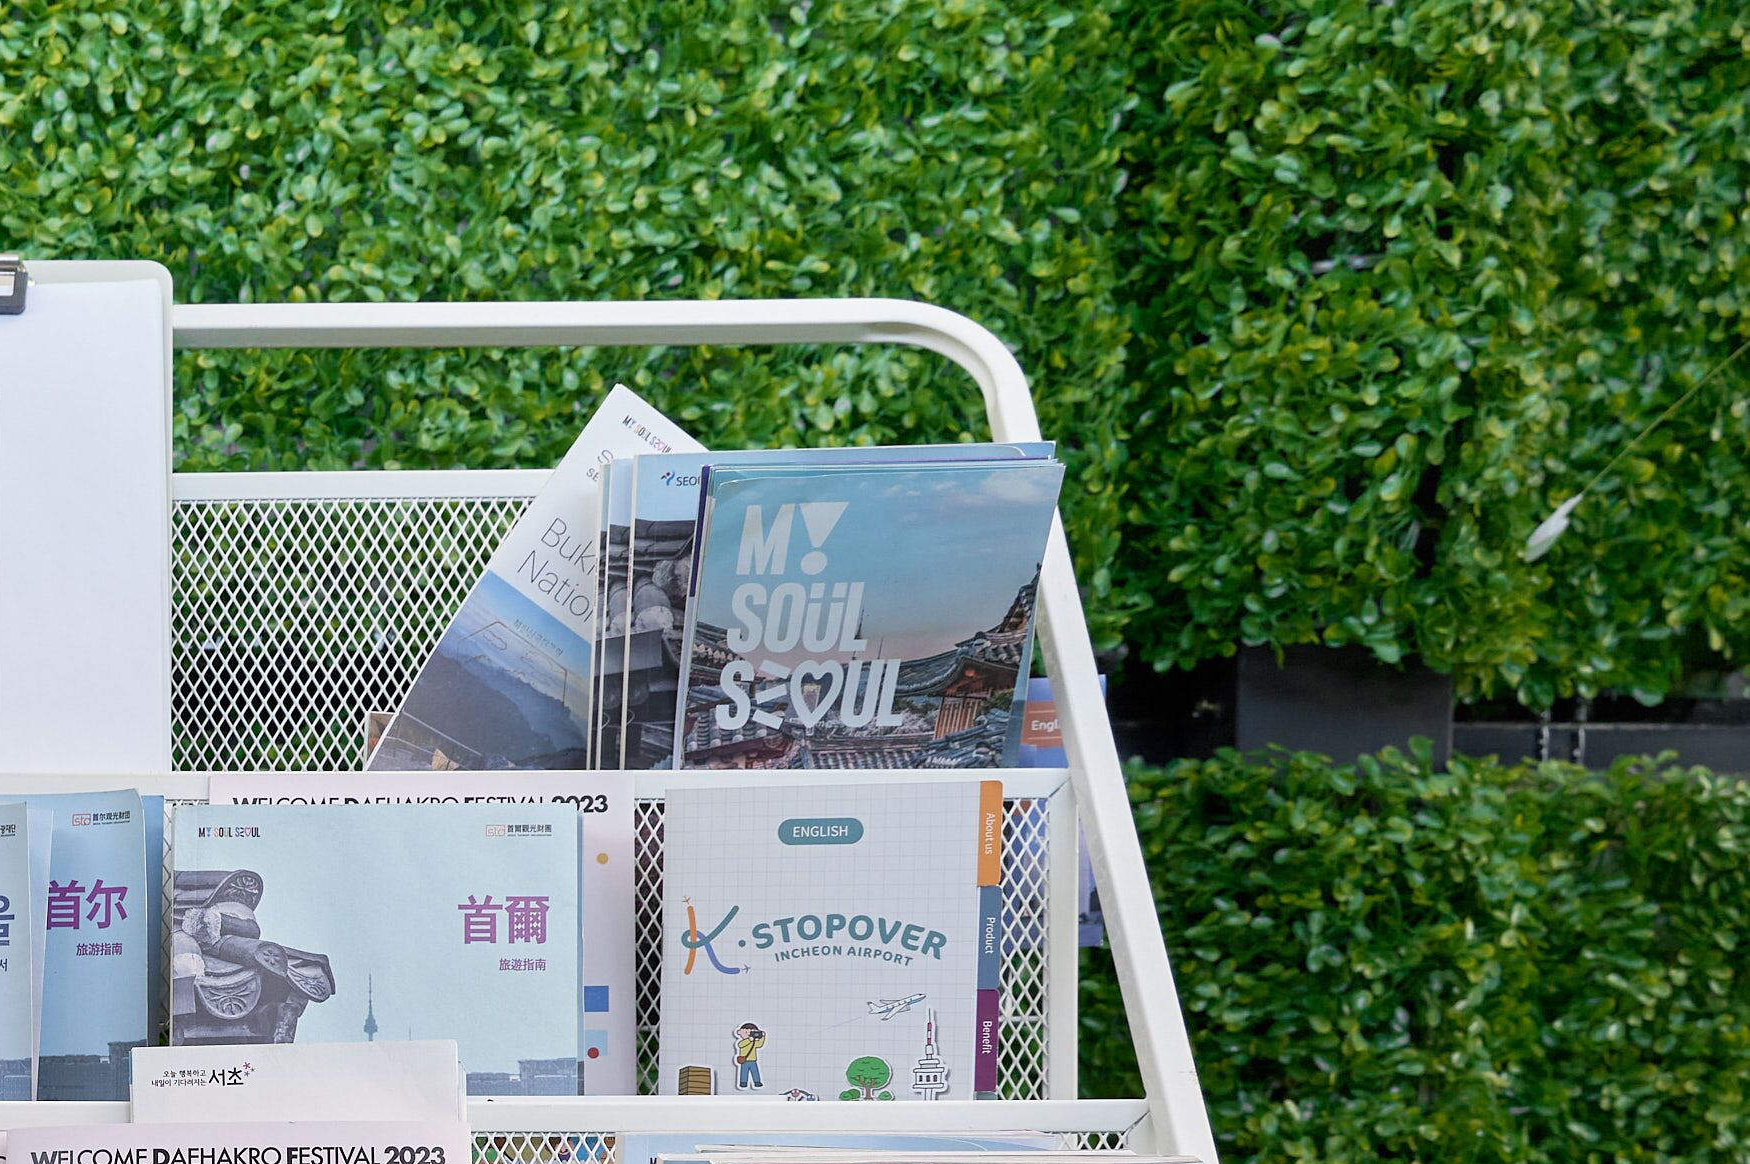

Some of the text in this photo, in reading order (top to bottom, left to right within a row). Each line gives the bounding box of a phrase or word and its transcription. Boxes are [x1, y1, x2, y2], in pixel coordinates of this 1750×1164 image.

[792, 824, 849, 839] ENGLISH
[984, 812, 996, 855] About us
[46, 877, 130, 931] 首尔
[457, 894, 550, 945] 首爾
[984, 916, 996, 954] Product
[75, 942, 123, 958] 旅游指南
[774, 945, 914, 967] INCHEON AIRPORT
[498, 957, 547, 973] 旅遊指南
[981, 1019, 993, 1054] Benefit
[151, 1078, 207, 1087] 내일이 기다려지는
[162, 1069, 207, 1078] 오늘 행복하고
[208, 1067, 244, 1086] 서초
